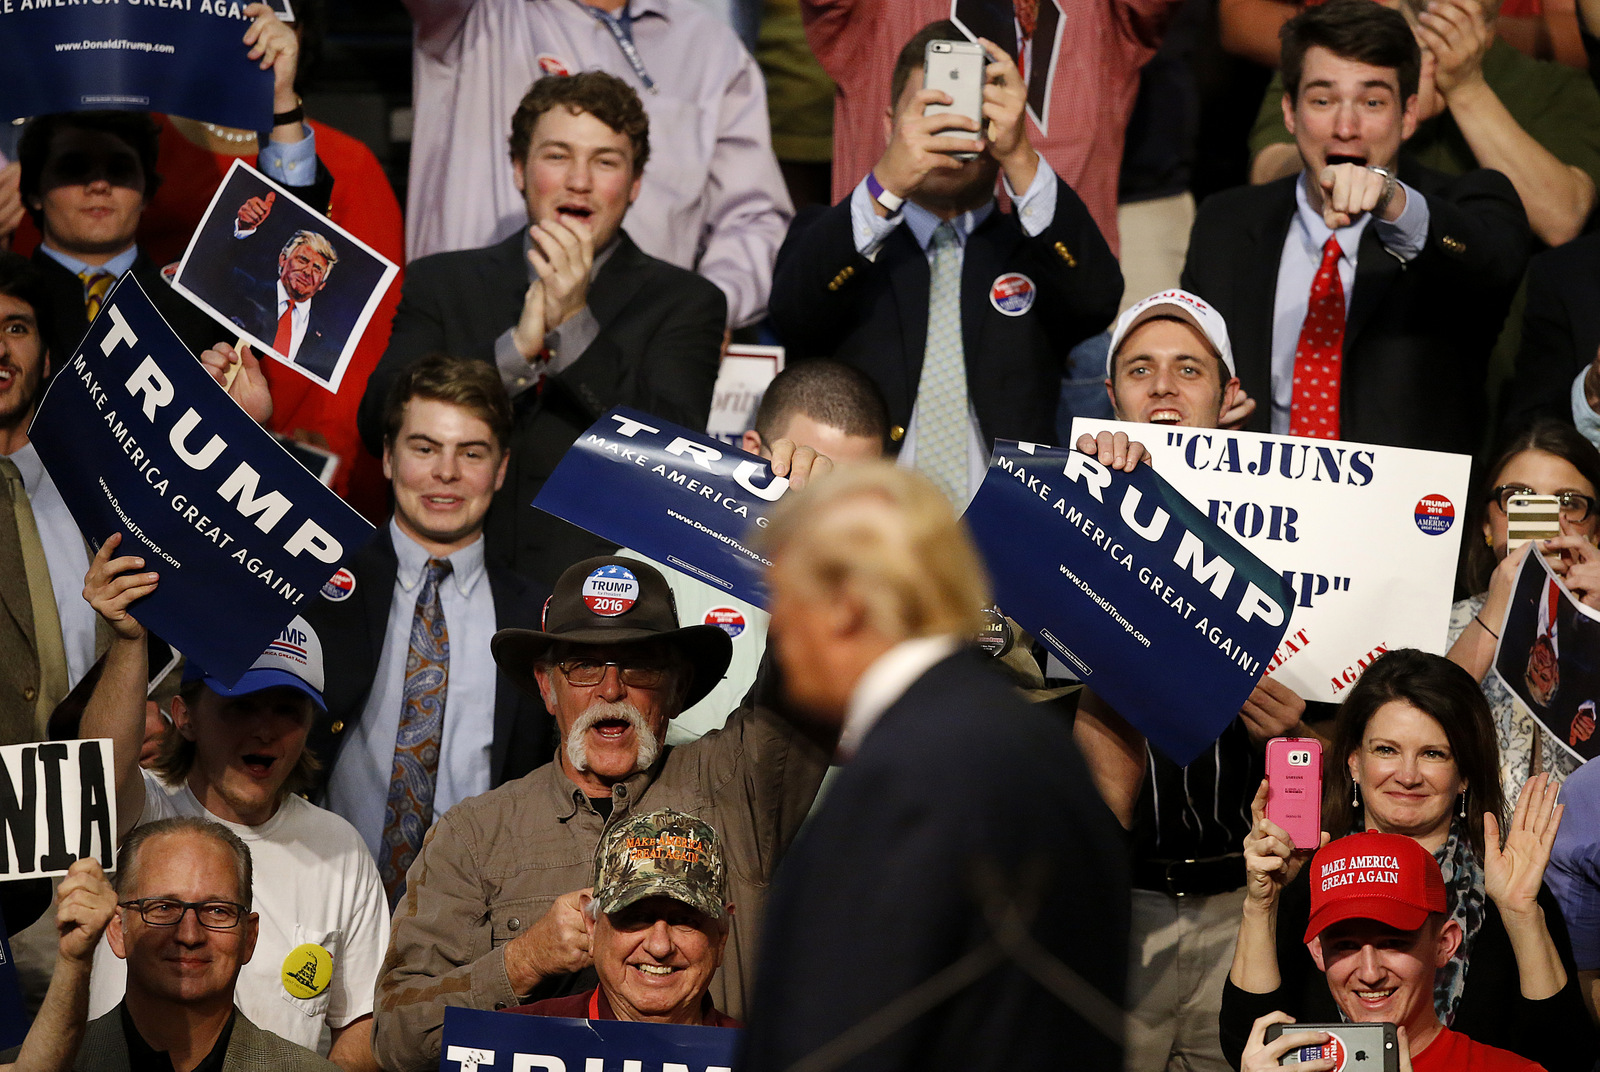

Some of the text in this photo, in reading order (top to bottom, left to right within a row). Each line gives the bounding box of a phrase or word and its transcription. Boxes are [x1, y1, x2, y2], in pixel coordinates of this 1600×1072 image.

[200, 0, 255, 22] AGAI
[55, 39, 174, 54] www.DonaldJTrump.com
[100, 303, 344, 564] TRUMP
[611, 413, 790, 501] TRU
[1166, 432, 1376, 486] "CAJUNS
[73, 354, 304, 605] MAKE AMERICA GREAT AGAIN!
[586, 434, 748, 518] MAKE AMERICA
[1420, 499, 1451, 508] TRUMP
[1427, 506, 1443, 514] 2016
[99, 476, 181, 569] www.DonaldJTrump.com
[667, 508, 775, 567] www.DonaldJTrump.co
[1207, 499, 1300, 543] FOR
[1417, 518, 1450, 528] AMERICA
[997, 455, 1260, 677] MAKE AMERICA GREAT AGAIN!
[592, 580, 632, 593] TRUMP
[593, 597, 623, 612] 2016
[1059, 563, 1151, 648] www.DonaldJTrump.com
[1263, 628, 1310, 676] EAT
[626, 835, 704, 853] MAKE AMERICA
[629, 847, 699, 863] GREAT AGAIN
[1321, 855, 1400, 878] MAKE AMERICA
[1321, 871, 1399, 892] GREAT AGAIN
